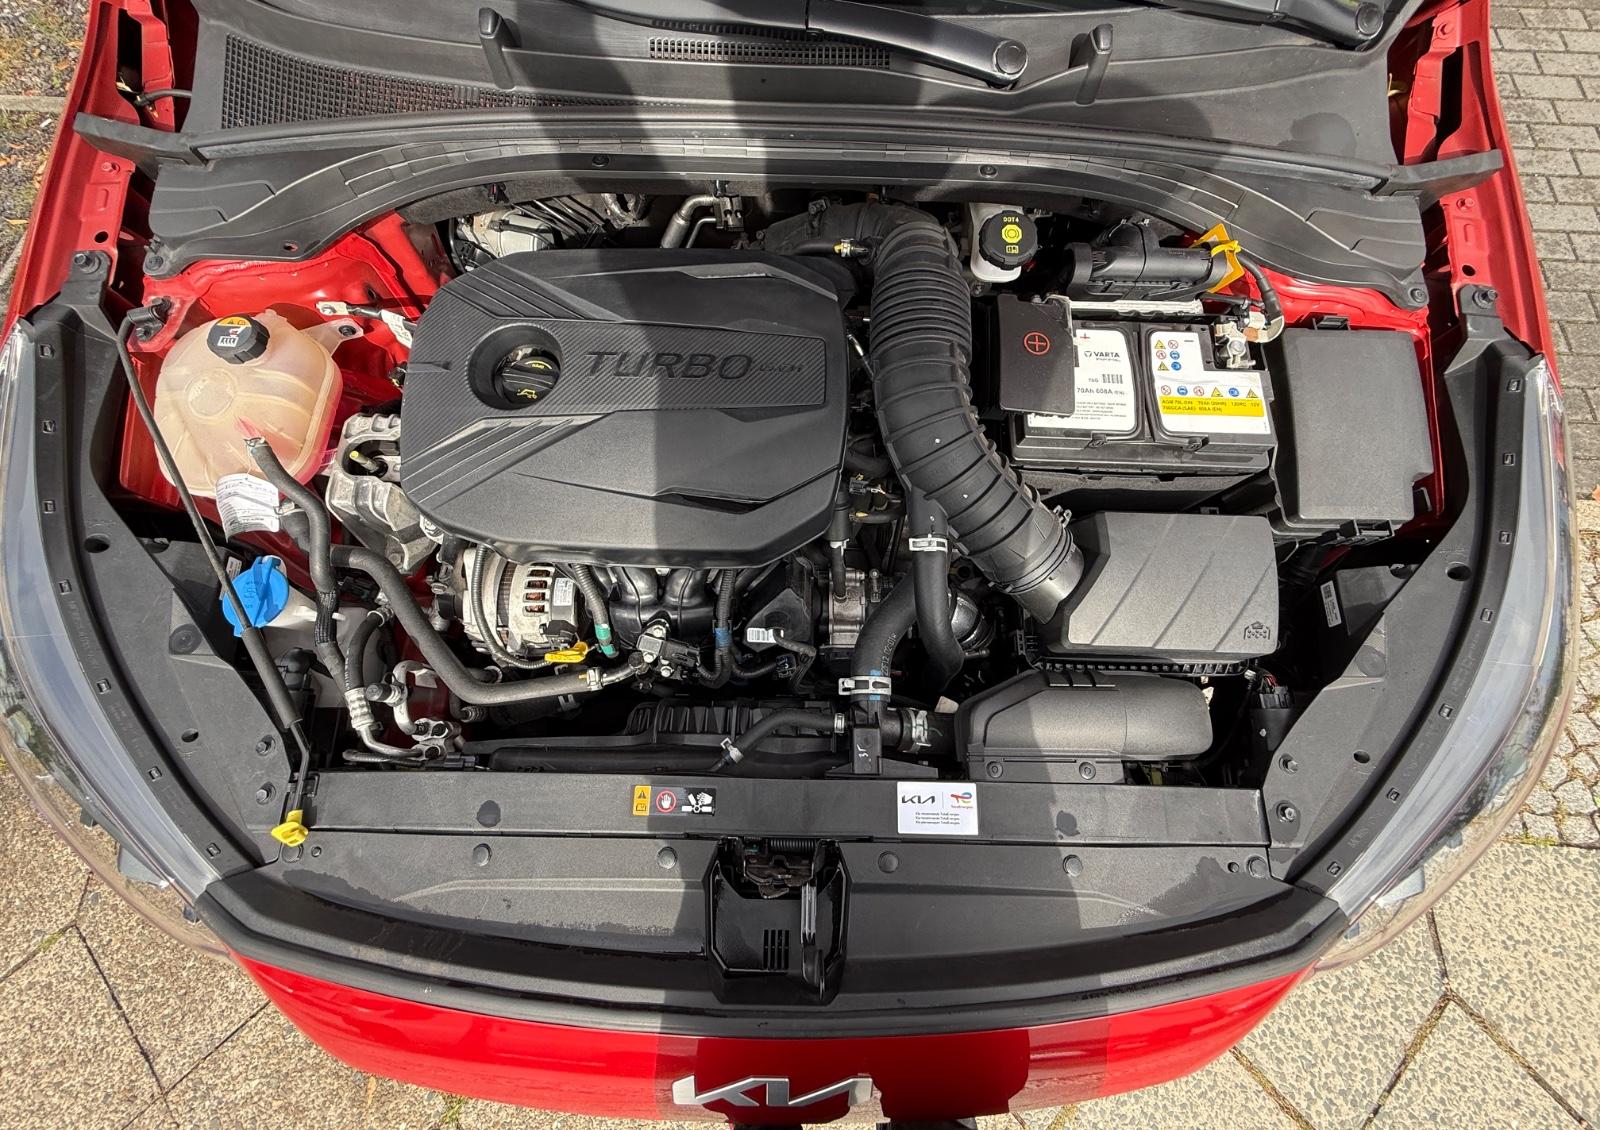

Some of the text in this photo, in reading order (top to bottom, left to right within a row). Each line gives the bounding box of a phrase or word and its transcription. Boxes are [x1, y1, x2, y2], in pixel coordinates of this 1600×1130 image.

[585, 351, 753, 379] TURBO
[901, 795, 936, 804] KIA
[671, 1075, 873, 1107] KIA
